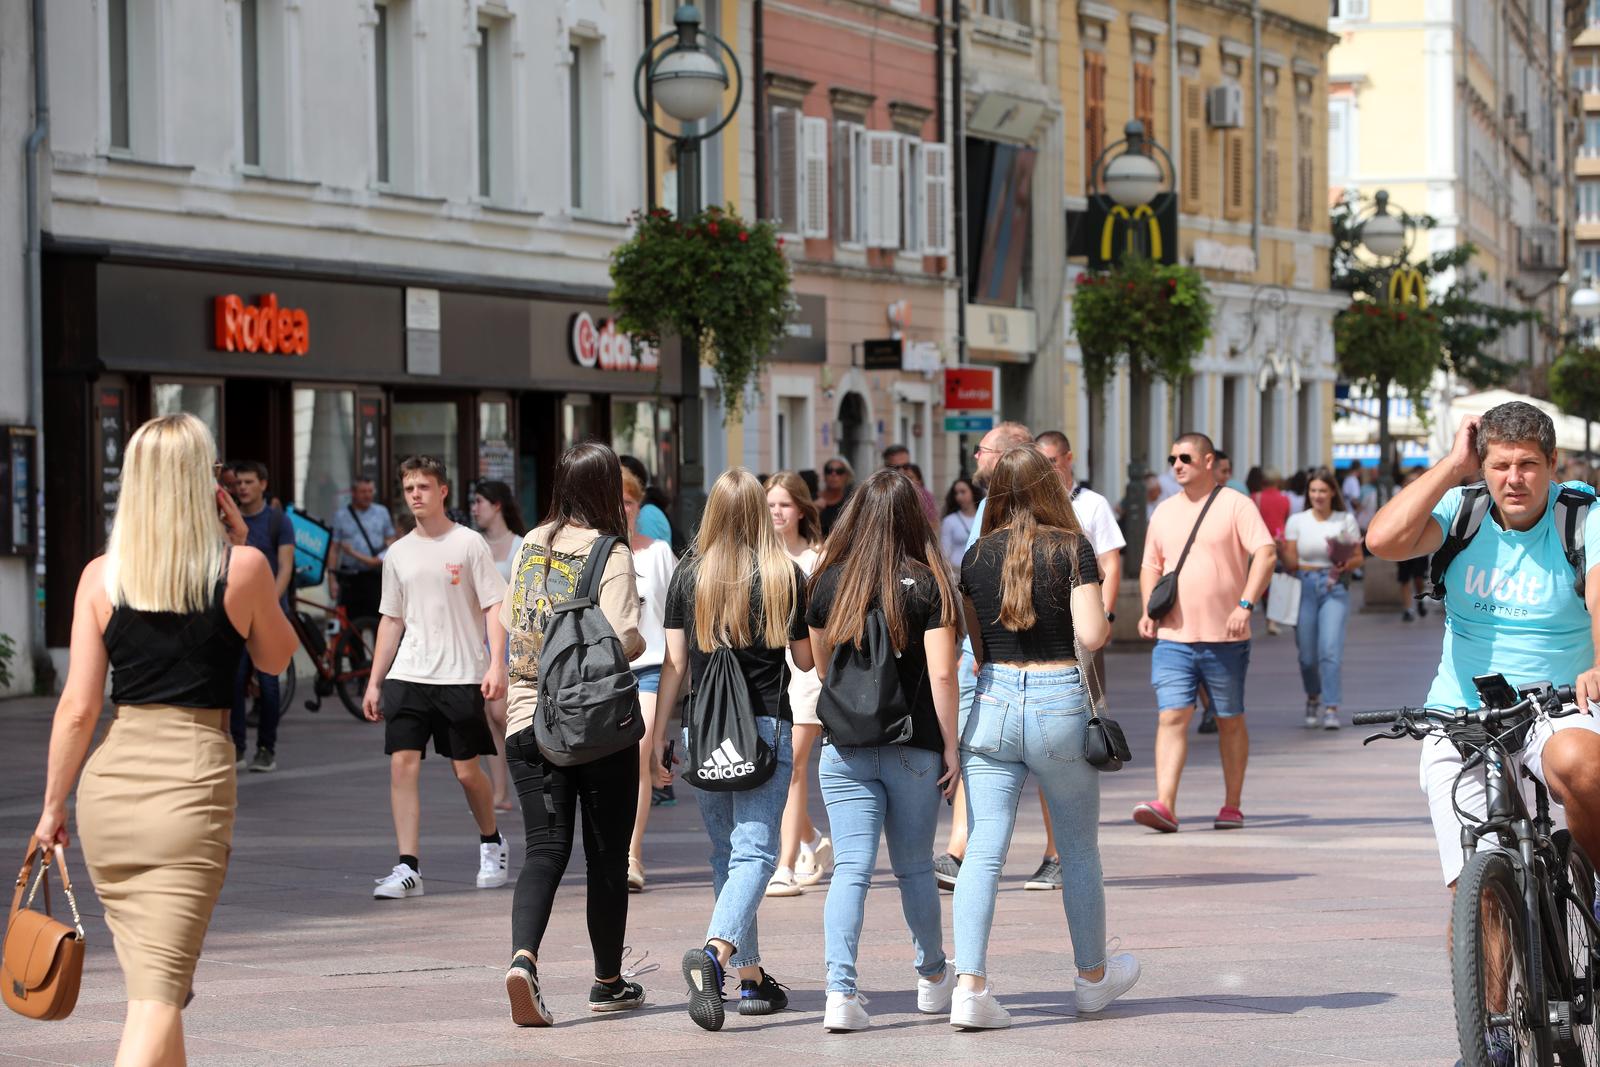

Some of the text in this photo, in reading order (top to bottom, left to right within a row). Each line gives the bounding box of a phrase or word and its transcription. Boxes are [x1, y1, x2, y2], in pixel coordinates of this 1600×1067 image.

[215, 292, 309, 356] Rodea
[1465, 565, 1542, 605] Wolt
[1474, 602, 1529, 617] PARTNER
[697, 761, 756, 780] adidas
